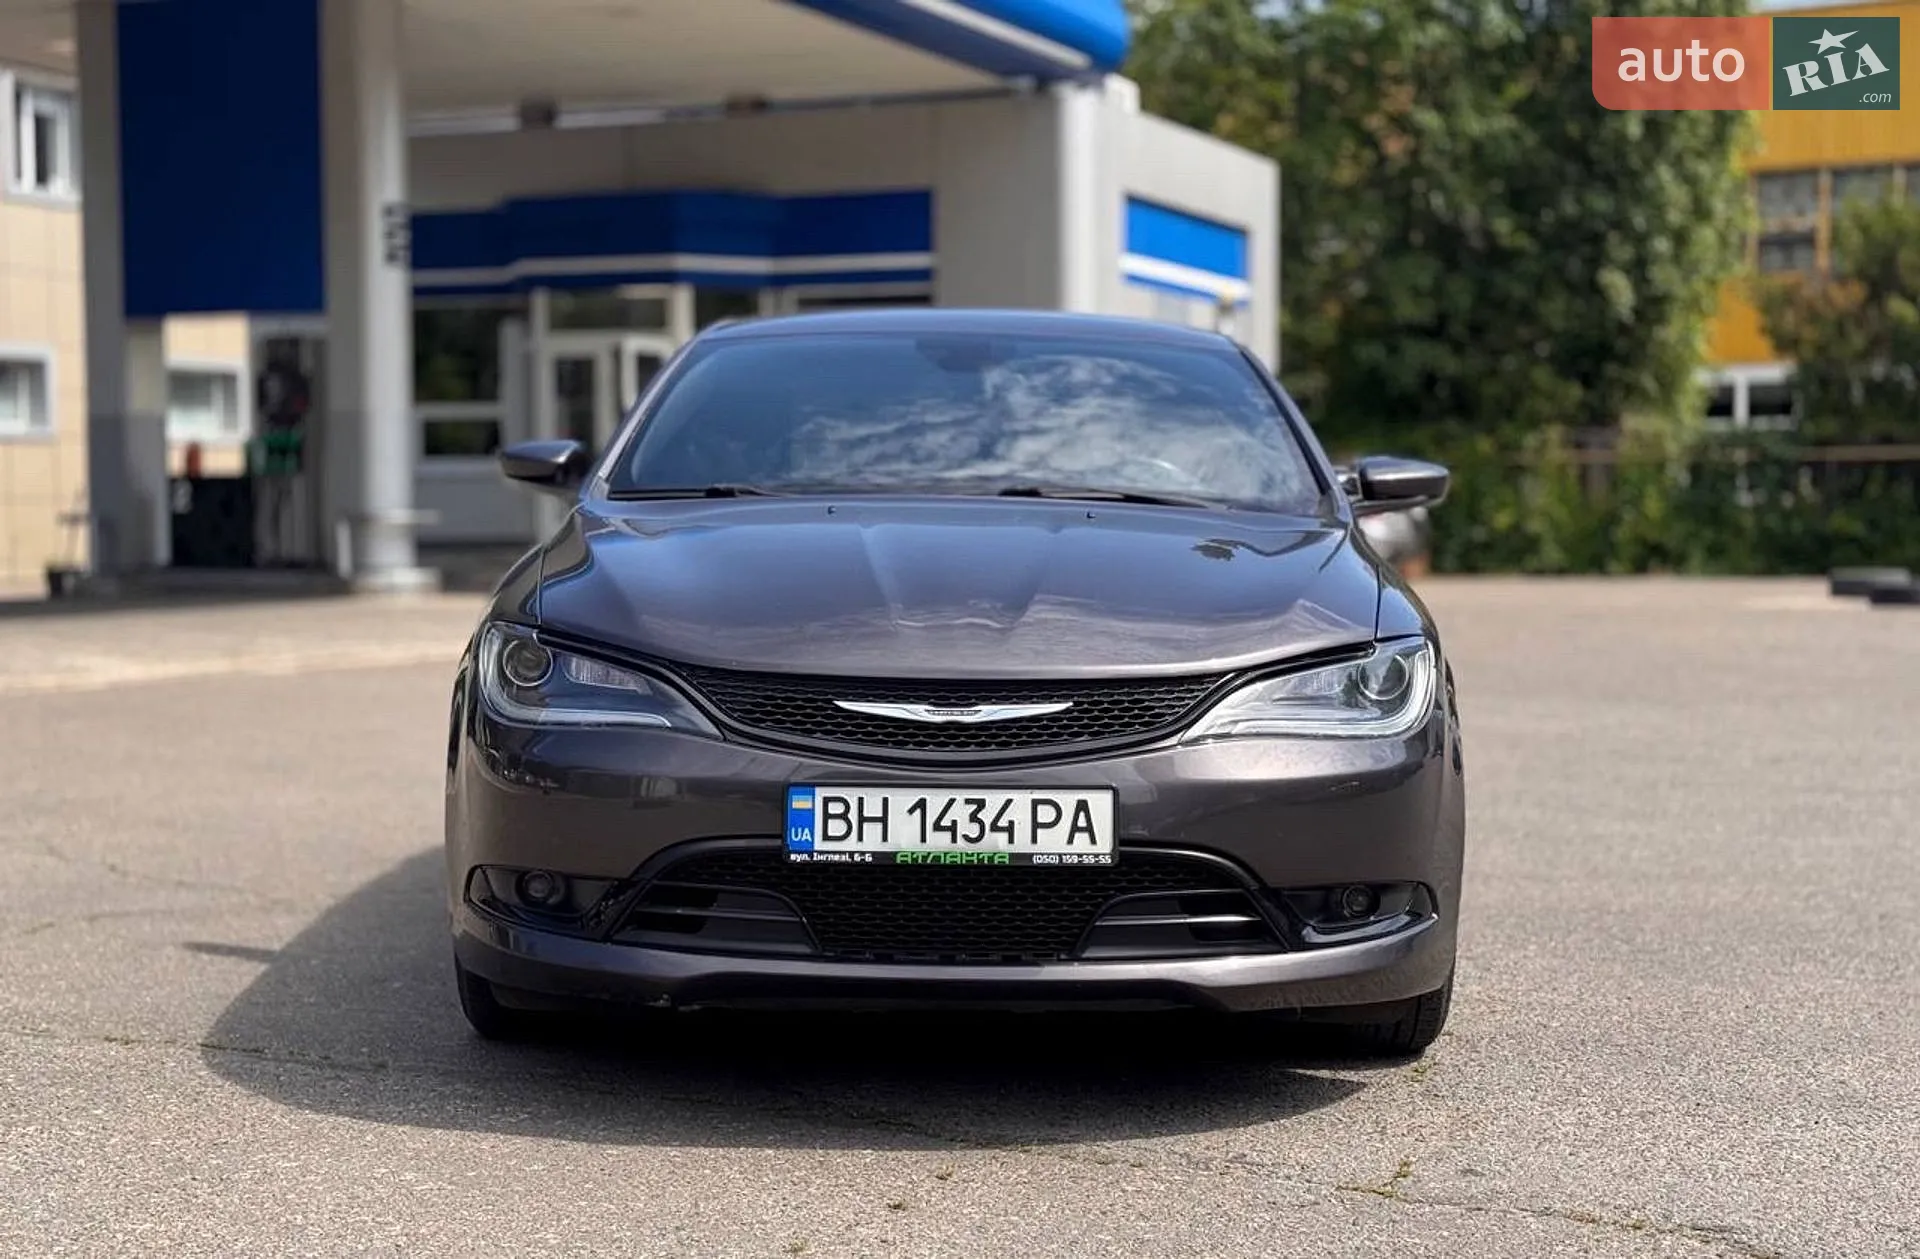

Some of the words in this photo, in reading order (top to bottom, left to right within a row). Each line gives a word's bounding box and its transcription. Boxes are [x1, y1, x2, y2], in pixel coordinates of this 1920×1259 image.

[791, 827, 812, 841] UA
[822, 796, 889, 842] BH
[906, 798, 1015, 845] 1434
[1030, 798, 1097, 845] PA
